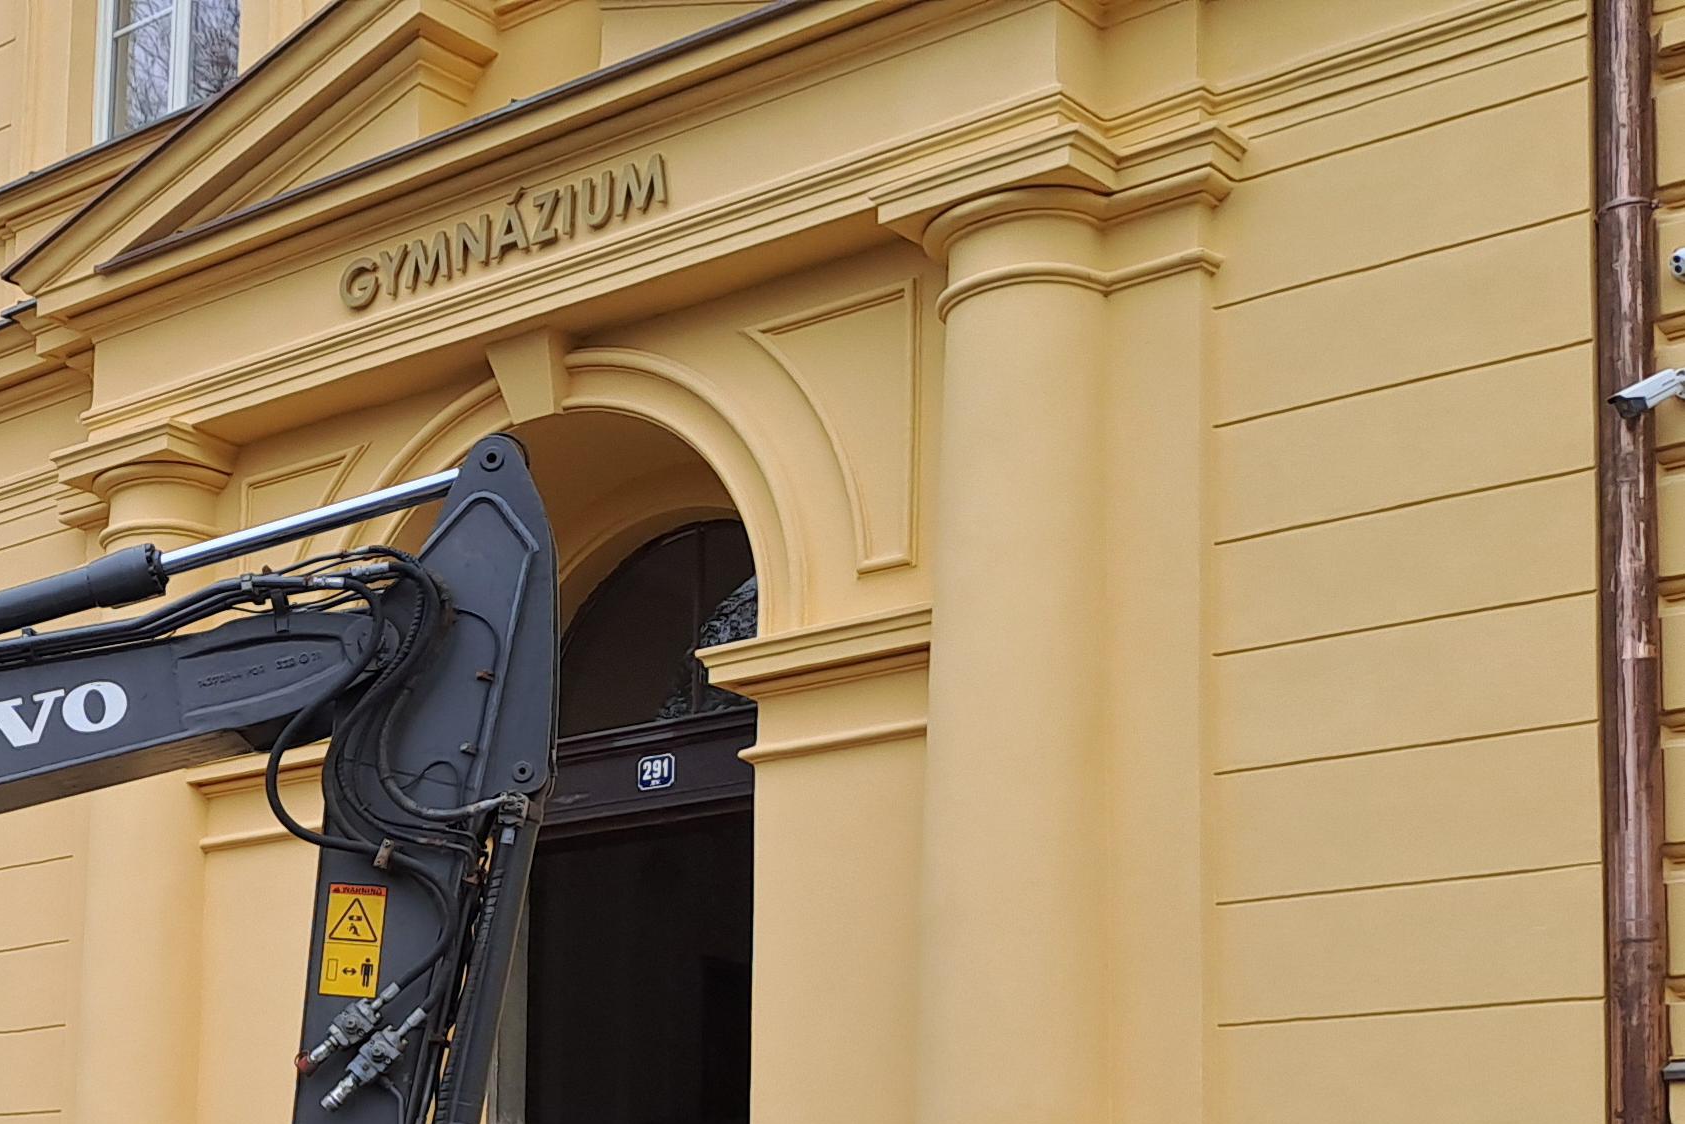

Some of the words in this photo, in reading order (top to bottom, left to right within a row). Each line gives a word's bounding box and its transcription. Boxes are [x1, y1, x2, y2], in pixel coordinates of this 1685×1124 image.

[339, 153, 667, 309] GYMNÁZIUM
[642, 758, 669, 781] 291
[342, 886, 383, 896] WARNING
